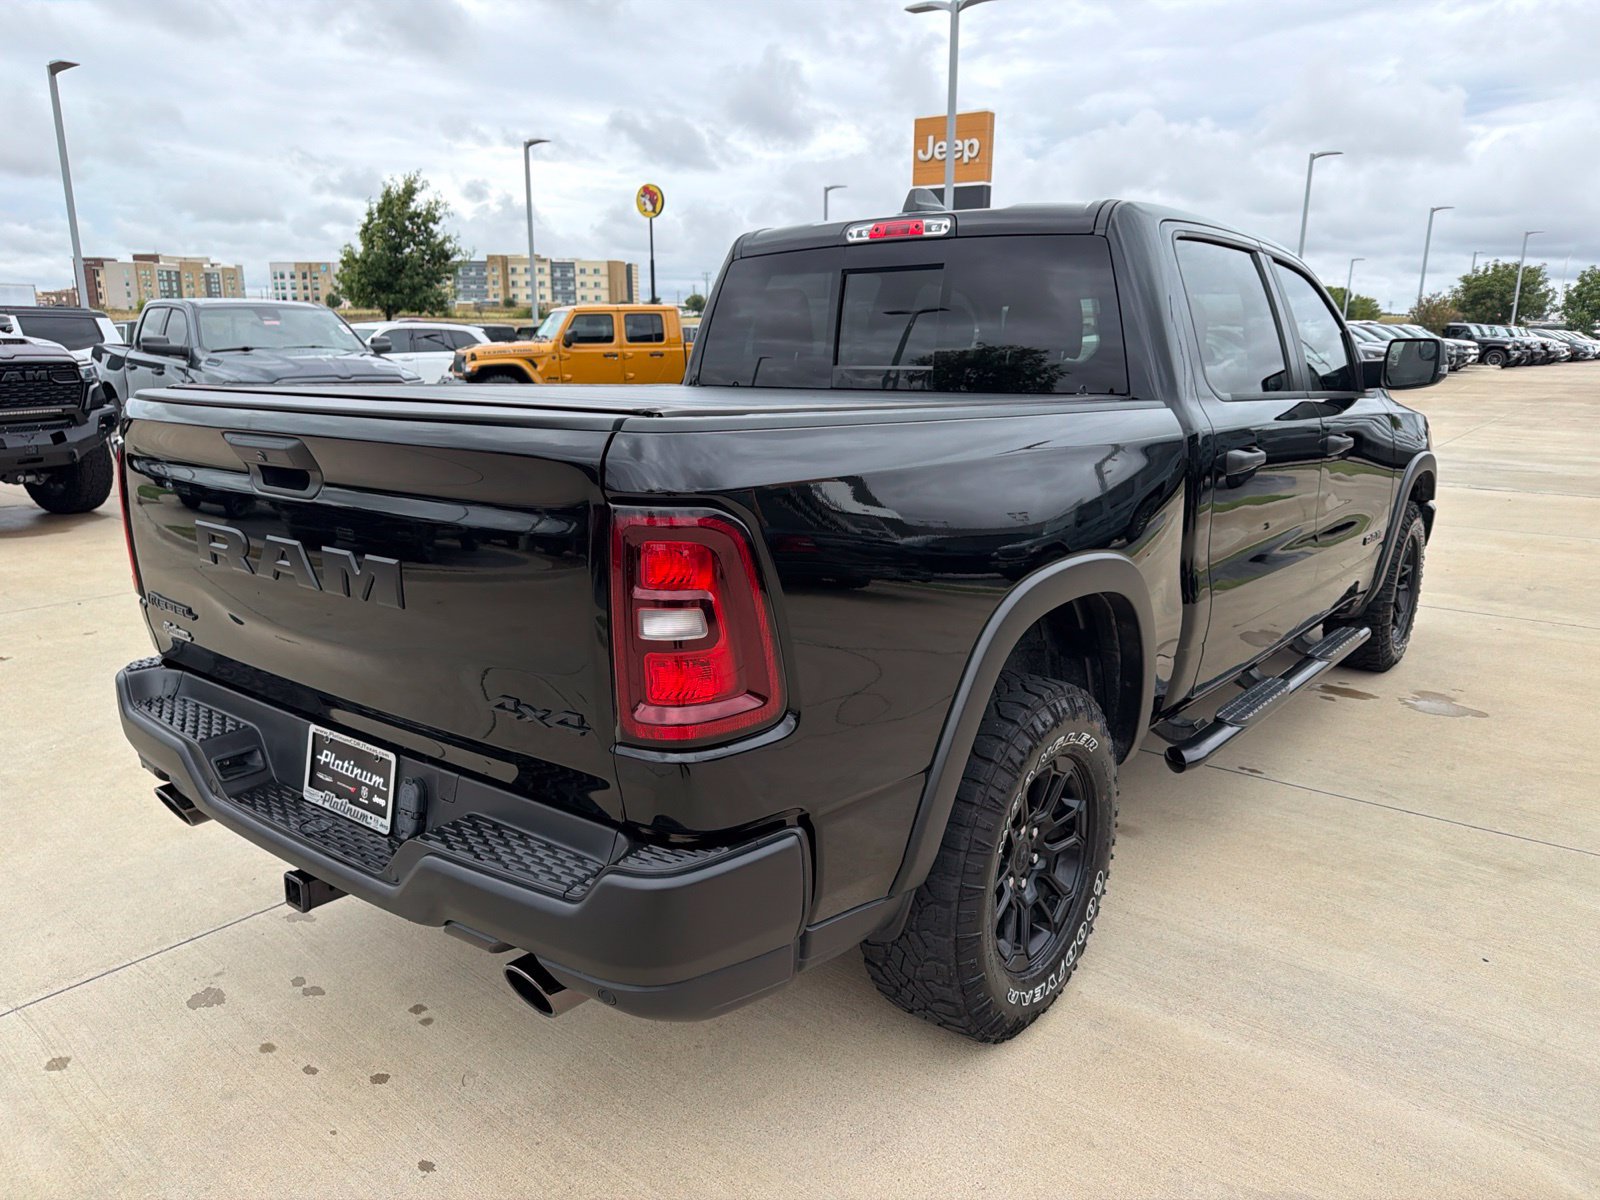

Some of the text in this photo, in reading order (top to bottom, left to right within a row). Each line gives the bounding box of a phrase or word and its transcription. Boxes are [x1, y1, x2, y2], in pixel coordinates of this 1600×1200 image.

[917, 135, 980, 164] Jeep
[195, 520, 405, 609] RAM
[147, 591, 199, 621] REBEL
[316, 749, 388, 791] Platinum
[321, 792, 373, 826] Platinum
[1007, 870, 1105, 1006] GOODYEAR
